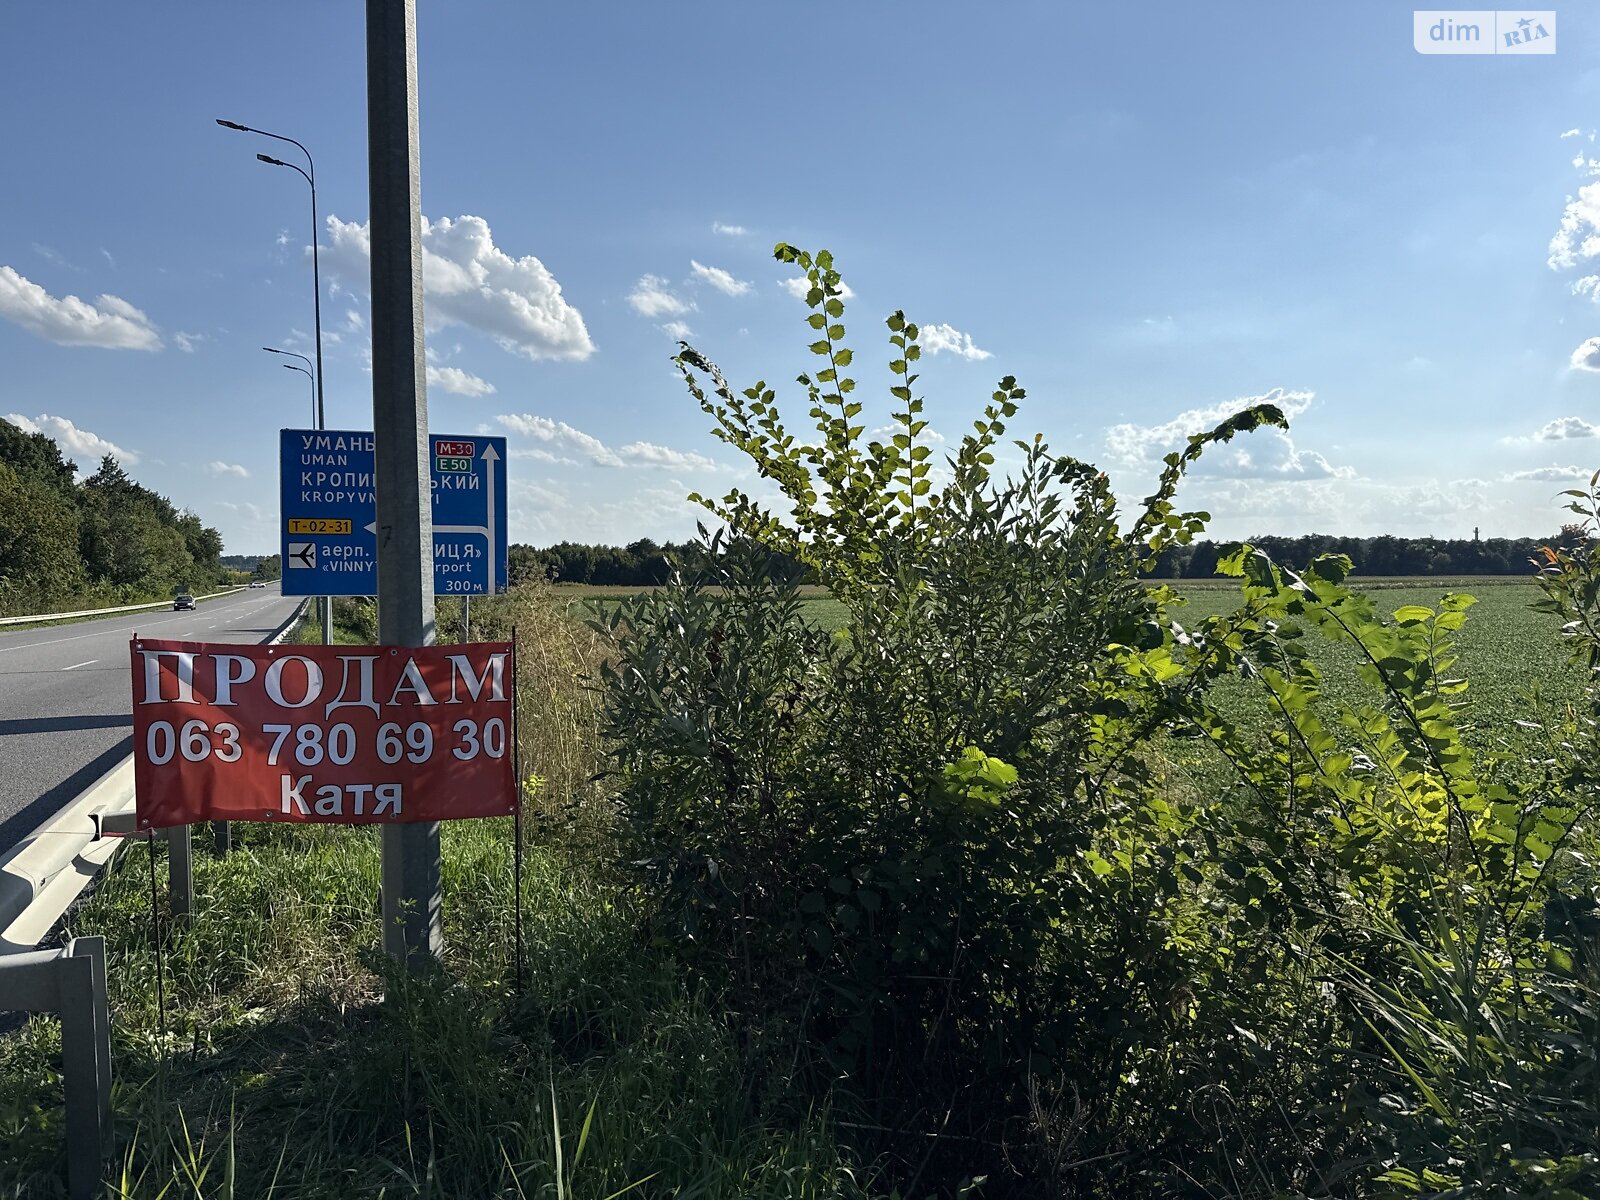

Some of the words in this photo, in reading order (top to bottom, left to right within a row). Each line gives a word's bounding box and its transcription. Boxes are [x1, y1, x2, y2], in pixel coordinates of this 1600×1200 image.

[302, 435, 375, 452] УМАНЬ
[301, 454, 348, 466] UMAN
[440, 459, 448, 470] E
[451, 459, 468, 471] 50
[322, 545, 370, 560] аерп.
[433, 561, 472, 575] rport
[445, 580, 471, 591] 300
[136, 649, 510, 721] ПРОДАМ
[146, 718, 243, 766] 063
[261, 722, 357, 767] 780
[376, 721, 434, 765] 69
[452, 717, 506, 761] 30
[279, 773, 403, 816] Катя
